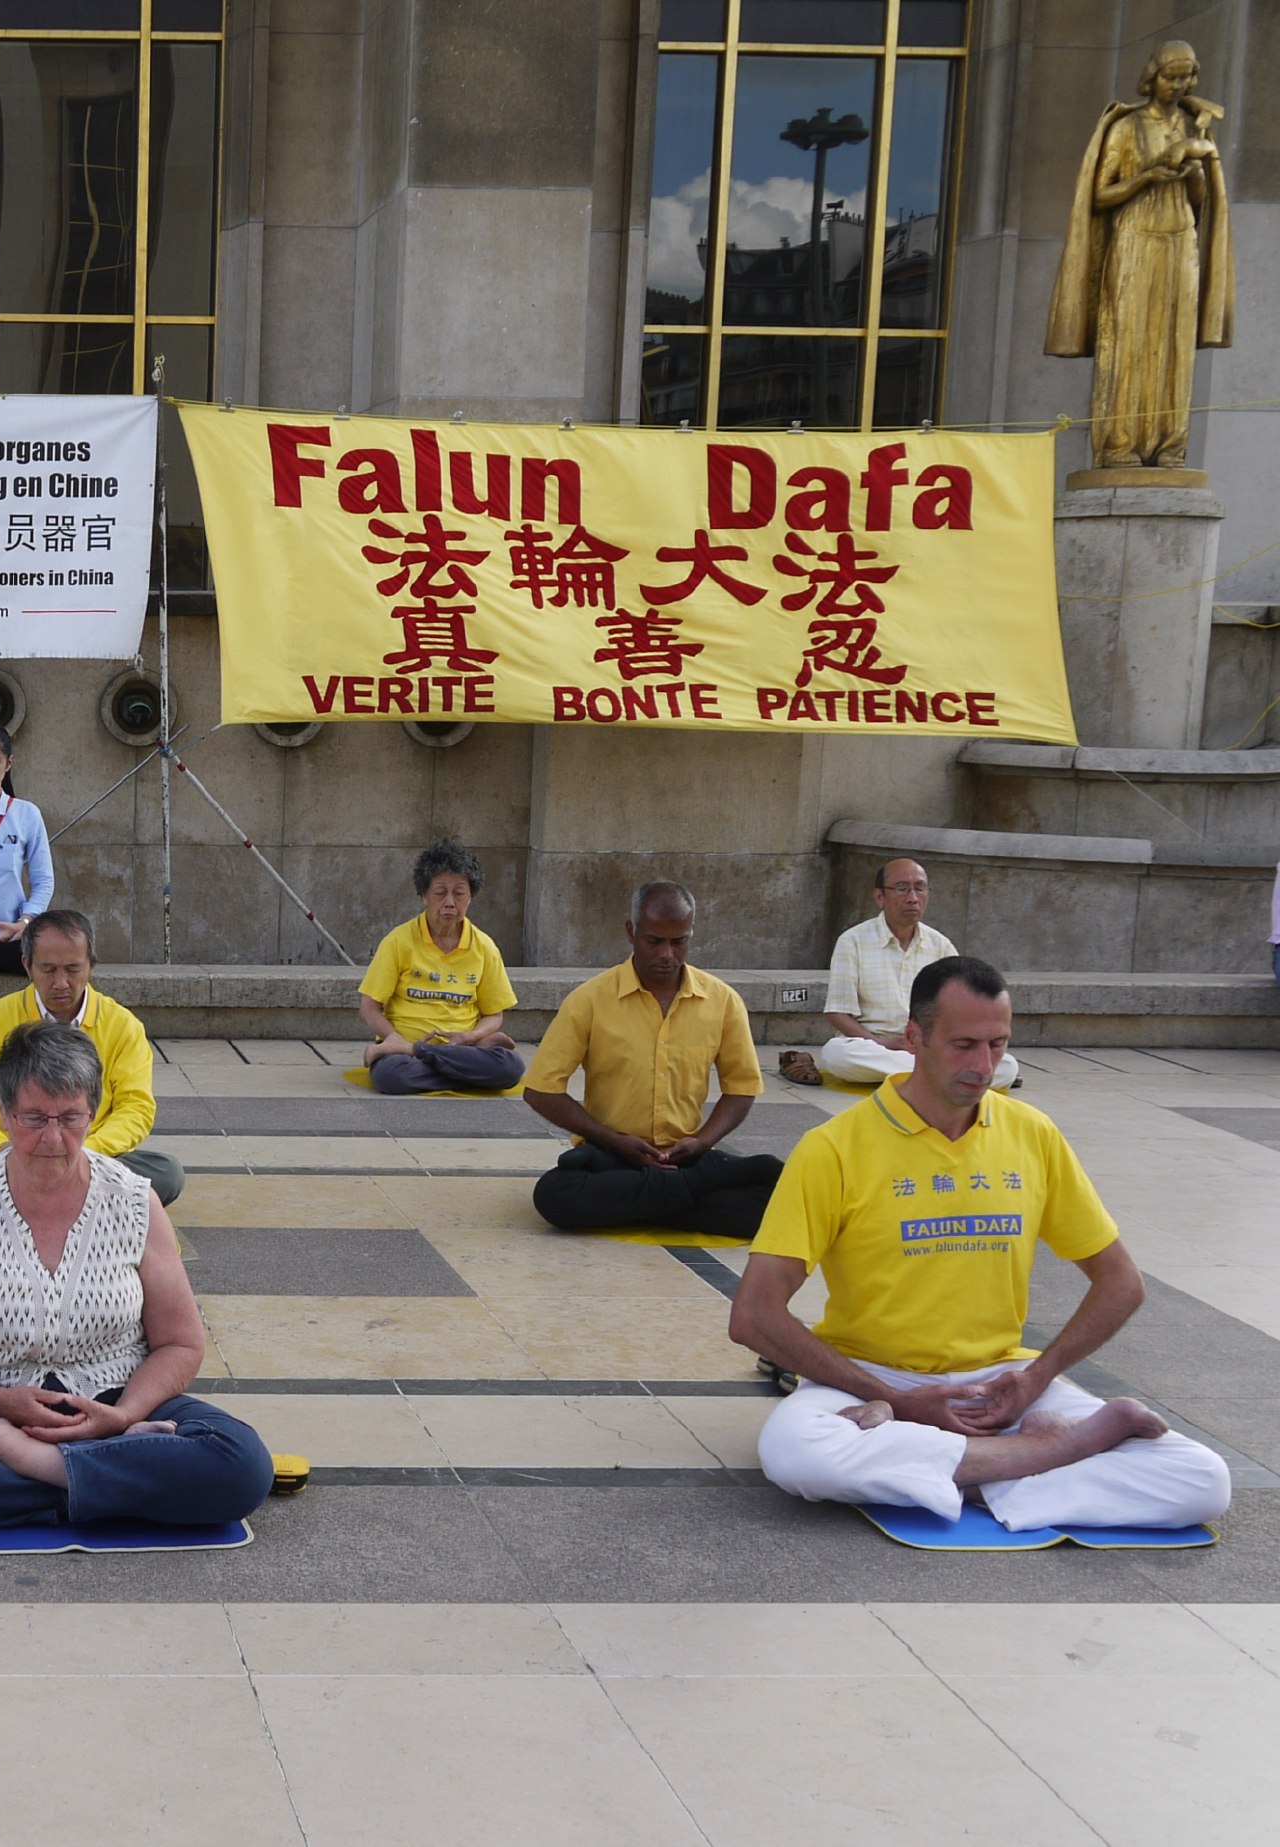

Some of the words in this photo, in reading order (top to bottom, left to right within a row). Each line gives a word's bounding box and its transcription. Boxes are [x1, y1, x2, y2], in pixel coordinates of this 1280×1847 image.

[13, 476, 42, 498] en
[48, 473, 119, 498] Chine
[266, 422, 582, 526] Falun
[706, 442, 975, 532] Dafa
[48, 569, 64, 586] in
[68, 569, 114, 585] China
[361, 513, 901, 618] 法輪大法
[383, 597, 499, 675] 真
[594, 607, 705, 680] 善
[795, 617, 908, 688] 忍
[301, 675, 496, 714] VERITE
[552, 681, 723, 723] BONTE
[756, 687, 1000, 727] PATIENCE
[892, 1171, 1022, 1198] 法輪大法
[907, 1219, 967, 1237] FALUN
[974, 1218, 1019, 1233] DAFA
[903, 1240, 1010, 1257] www.falundafa.org
